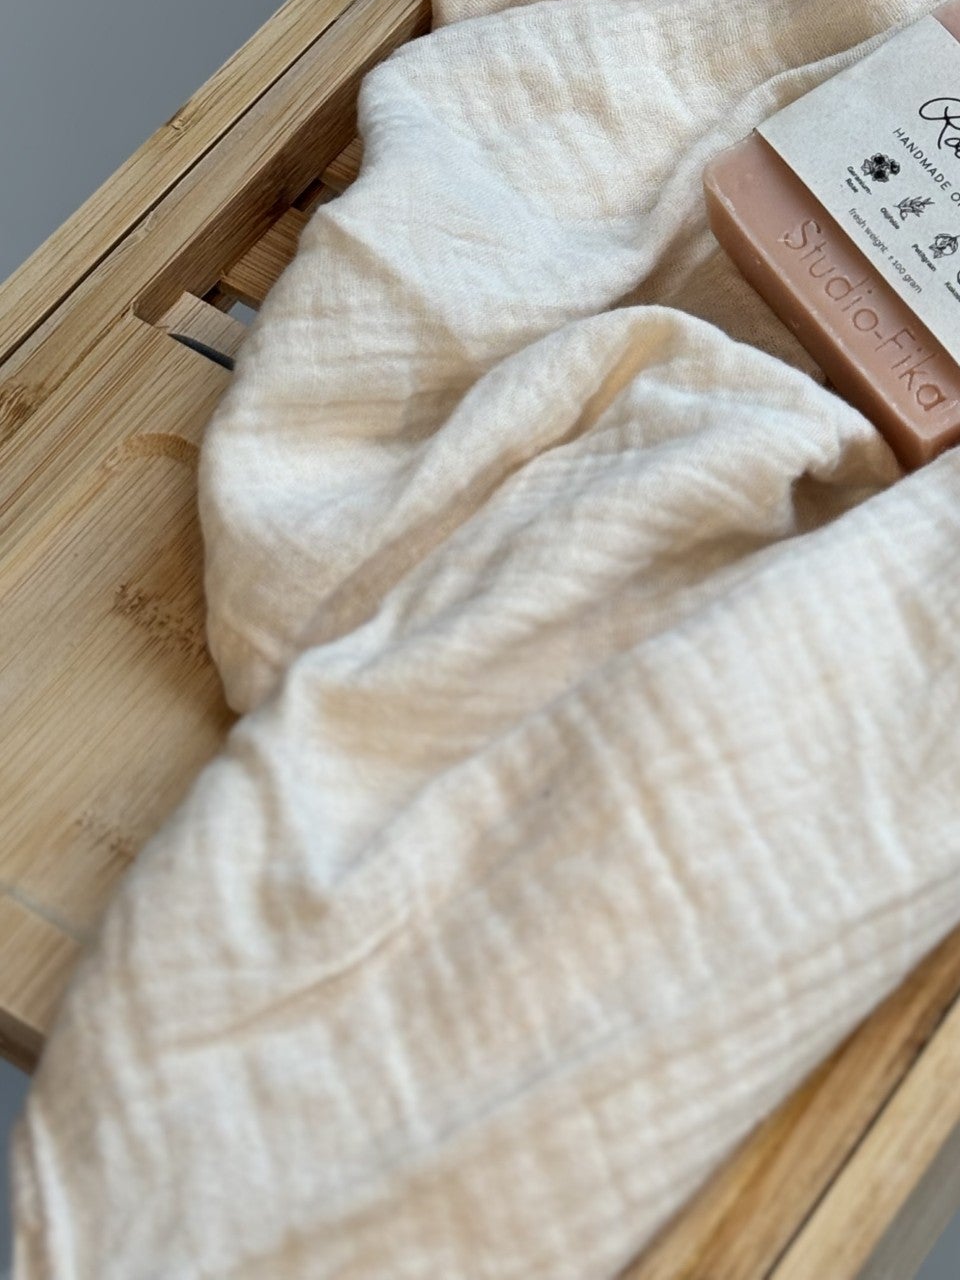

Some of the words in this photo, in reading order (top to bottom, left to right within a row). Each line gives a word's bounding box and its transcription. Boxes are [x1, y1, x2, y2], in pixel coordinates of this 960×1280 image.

[893, 127, 952, 191] HANDMADE
[849, 208, 867, 230] fresh
[892, 260, 906, 275] 100
[902, 274, 923, 294] gram
[784, 220, 947, 412] Studio-Fika
